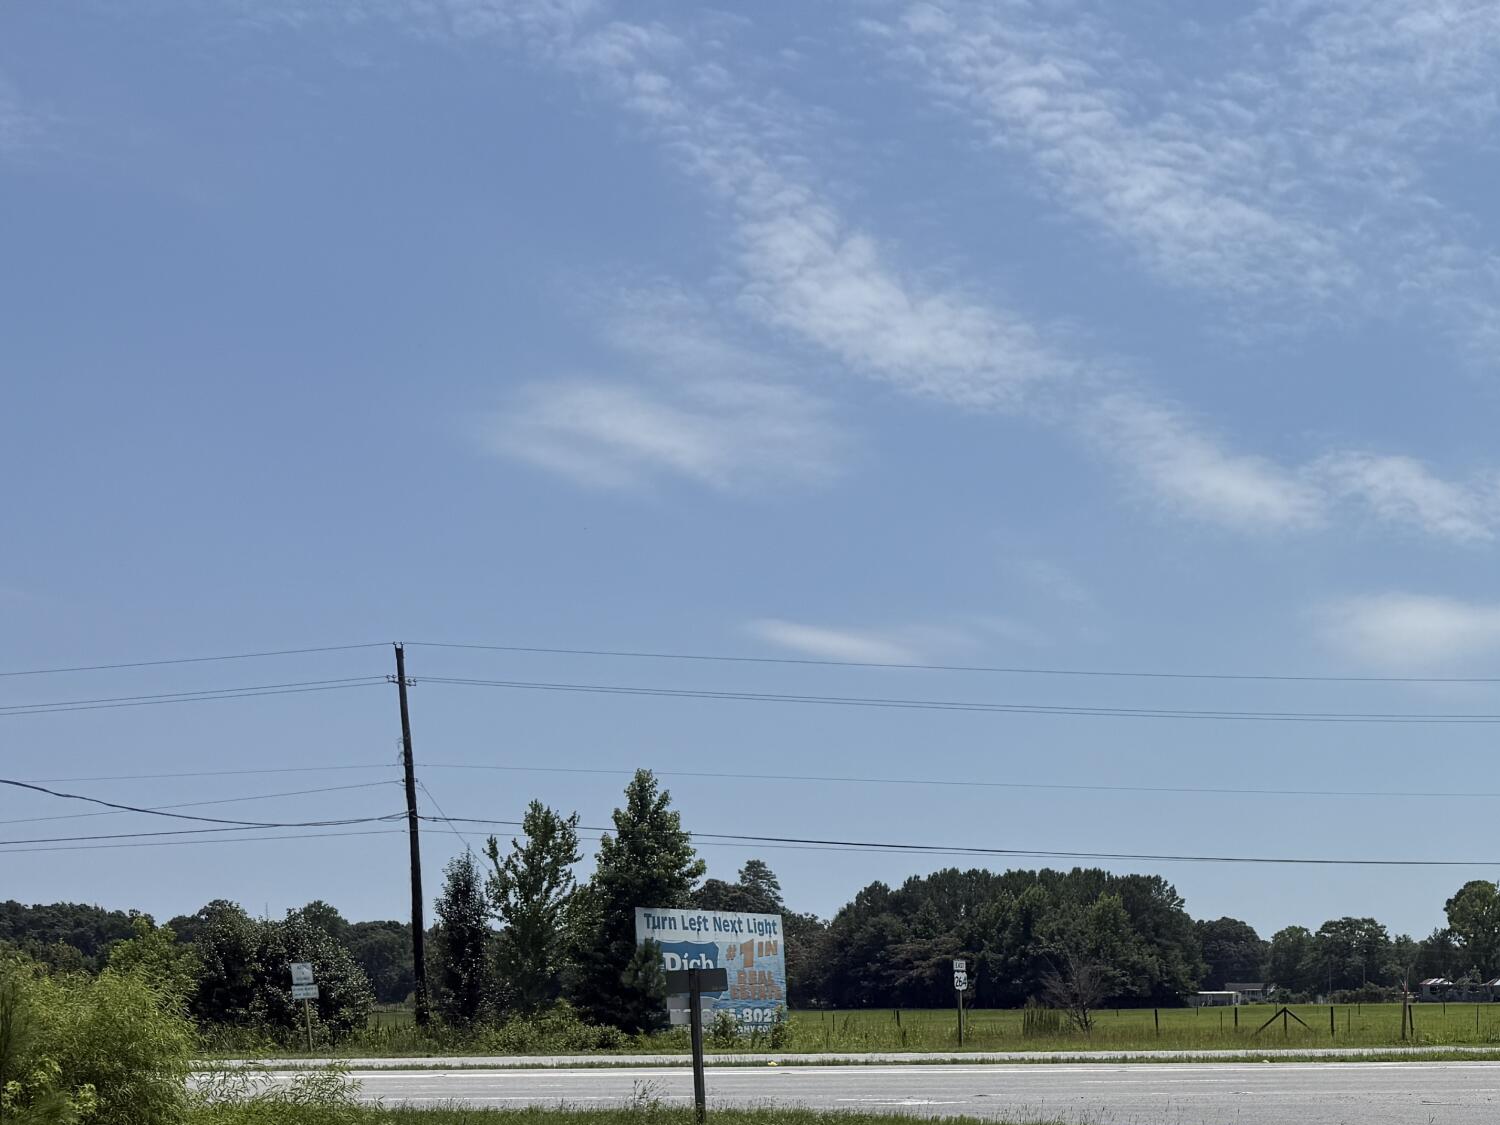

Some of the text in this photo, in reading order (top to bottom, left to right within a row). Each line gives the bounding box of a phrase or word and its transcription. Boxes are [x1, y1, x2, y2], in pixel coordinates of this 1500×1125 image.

[643, 913, 778, 936] Turn Left Next Light
[757, 940, 778, 957] IN
